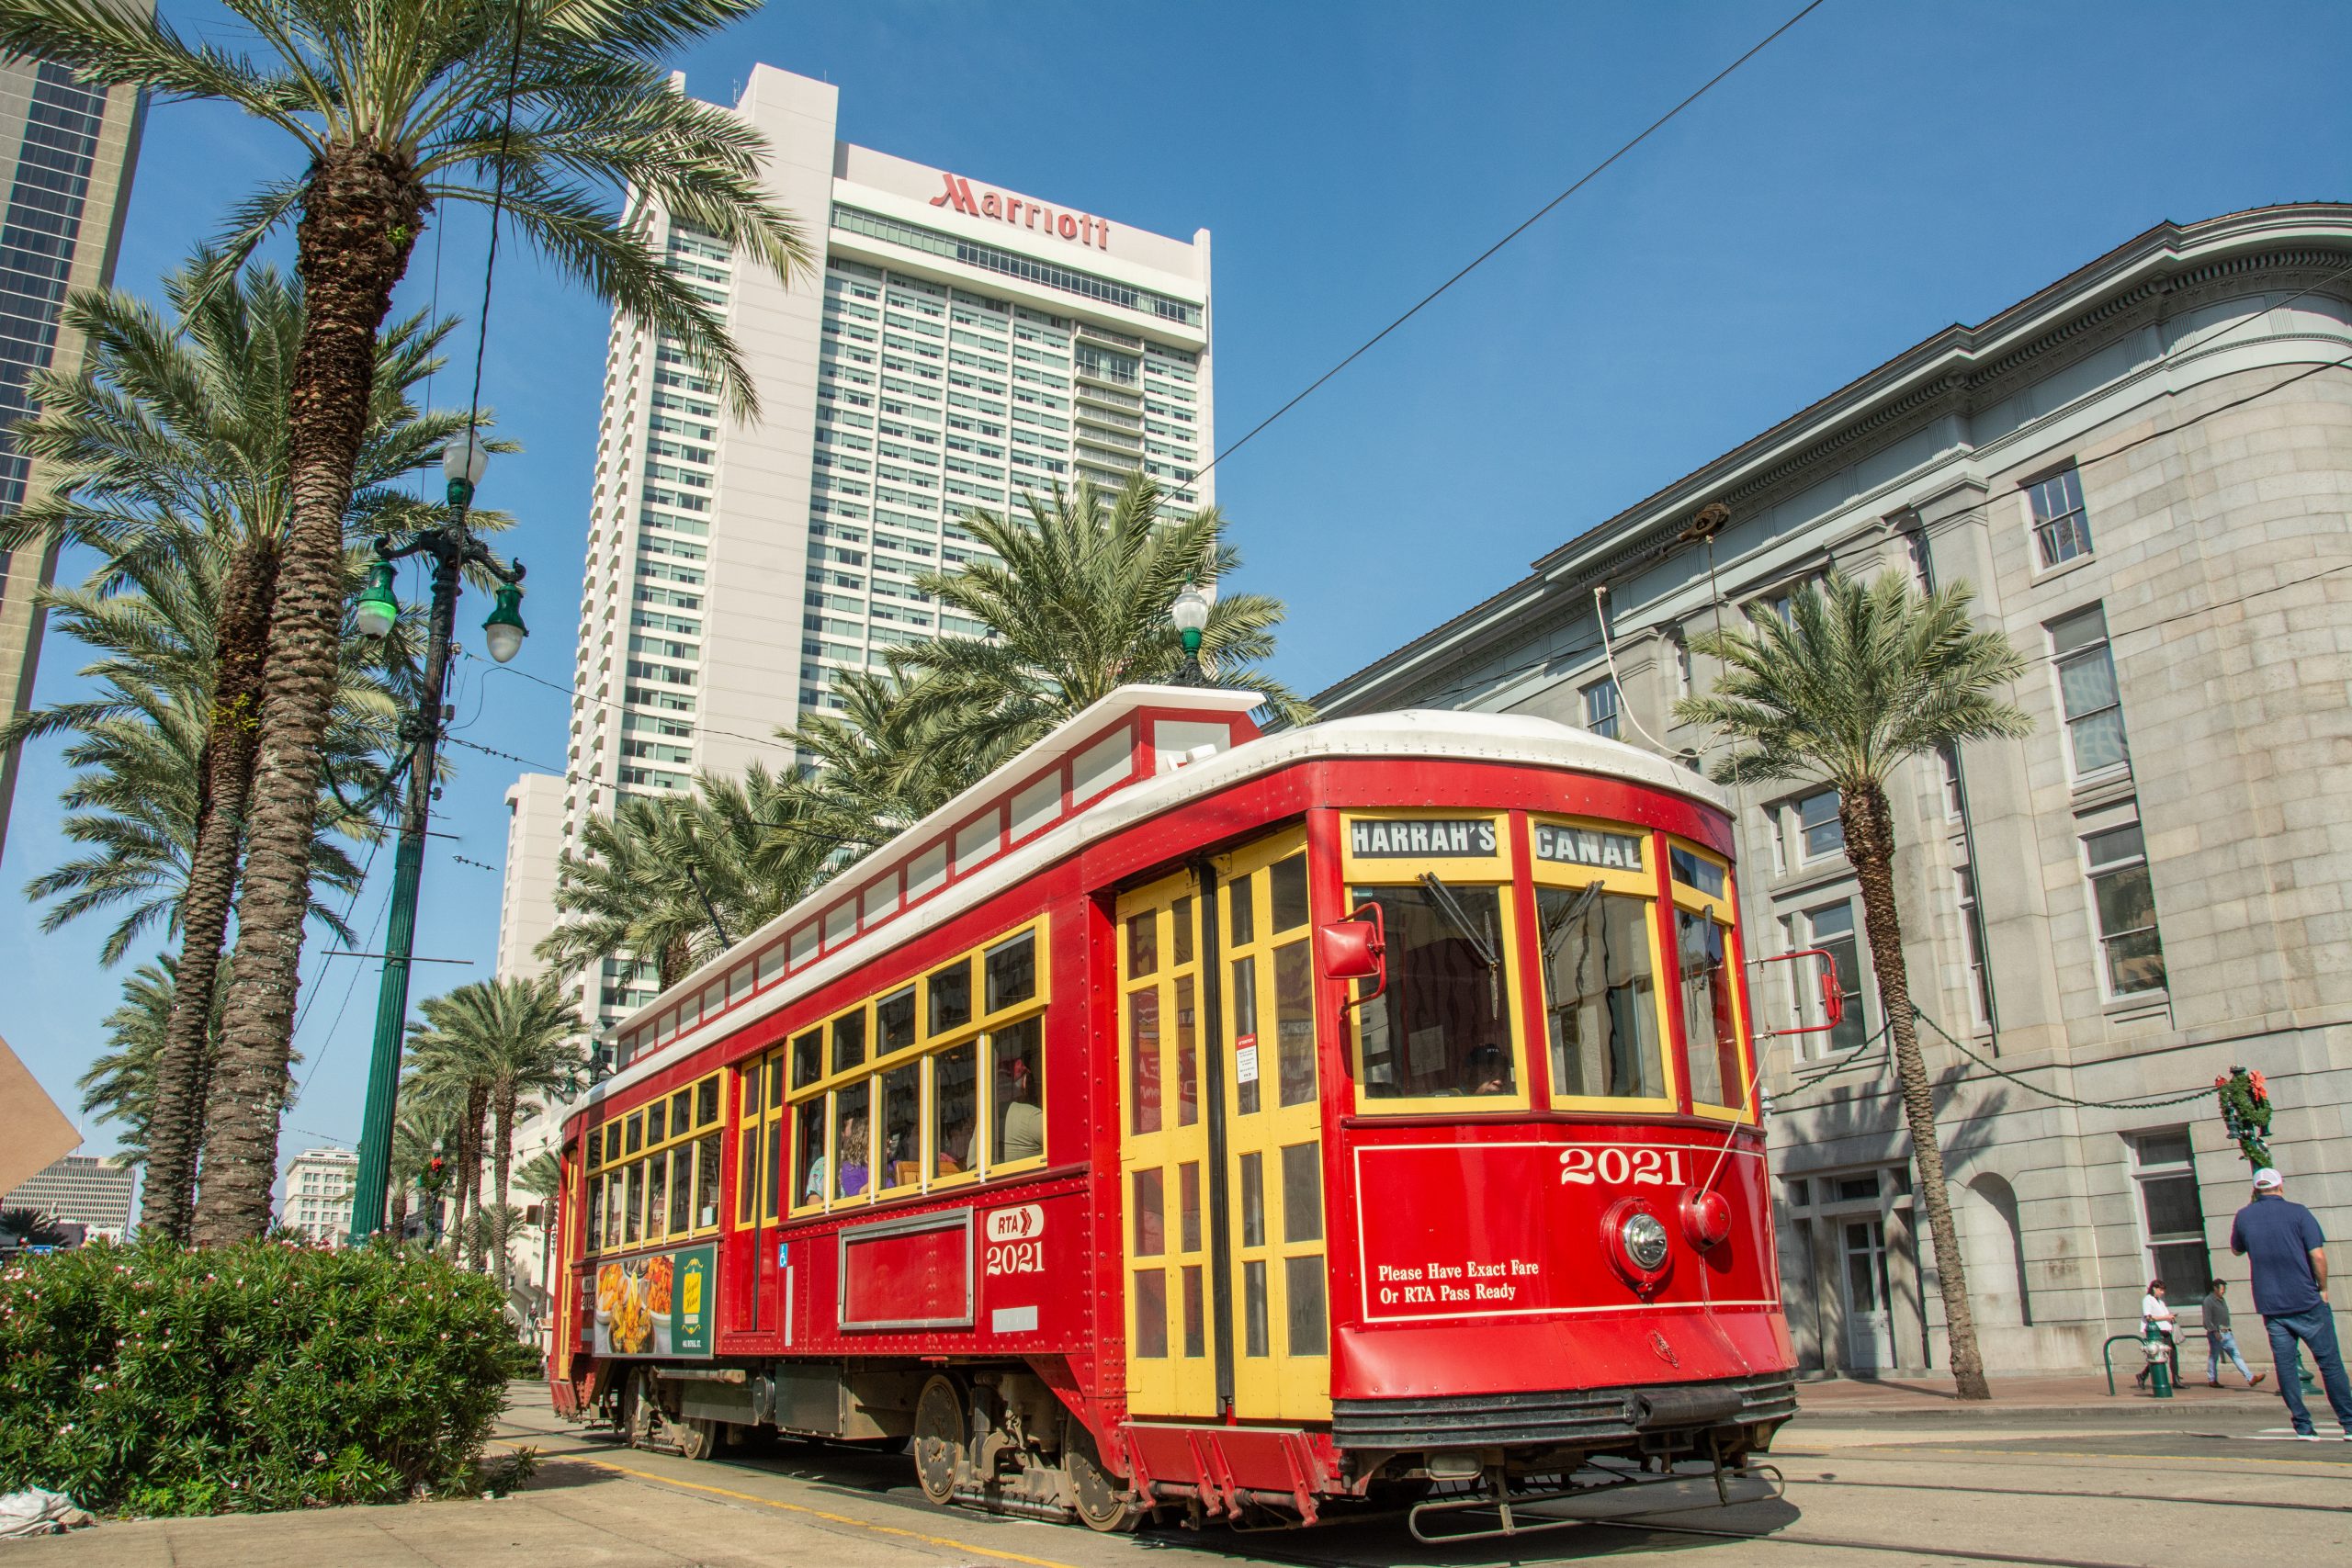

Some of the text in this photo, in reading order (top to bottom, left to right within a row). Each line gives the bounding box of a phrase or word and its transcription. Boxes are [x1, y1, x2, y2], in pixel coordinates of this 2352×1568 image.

[929, 173, 1110, 251] Marriott
[1351, 821, 1497, 852] HARRAH'S
[1535, 828, 1643, 869] CANAL
[1559, 1147, 1686, 1186] 2021
[998, 1214, 1019, 1235] RTA
[987, 1241, 1045, 1276] 2021
[1378, 1259, 1539, 1281] Please Have Exact Fare
[581, 1294, 595, 1312] 202
[1380, 1282, 1516, 1304] Or RTA Pass Ready
